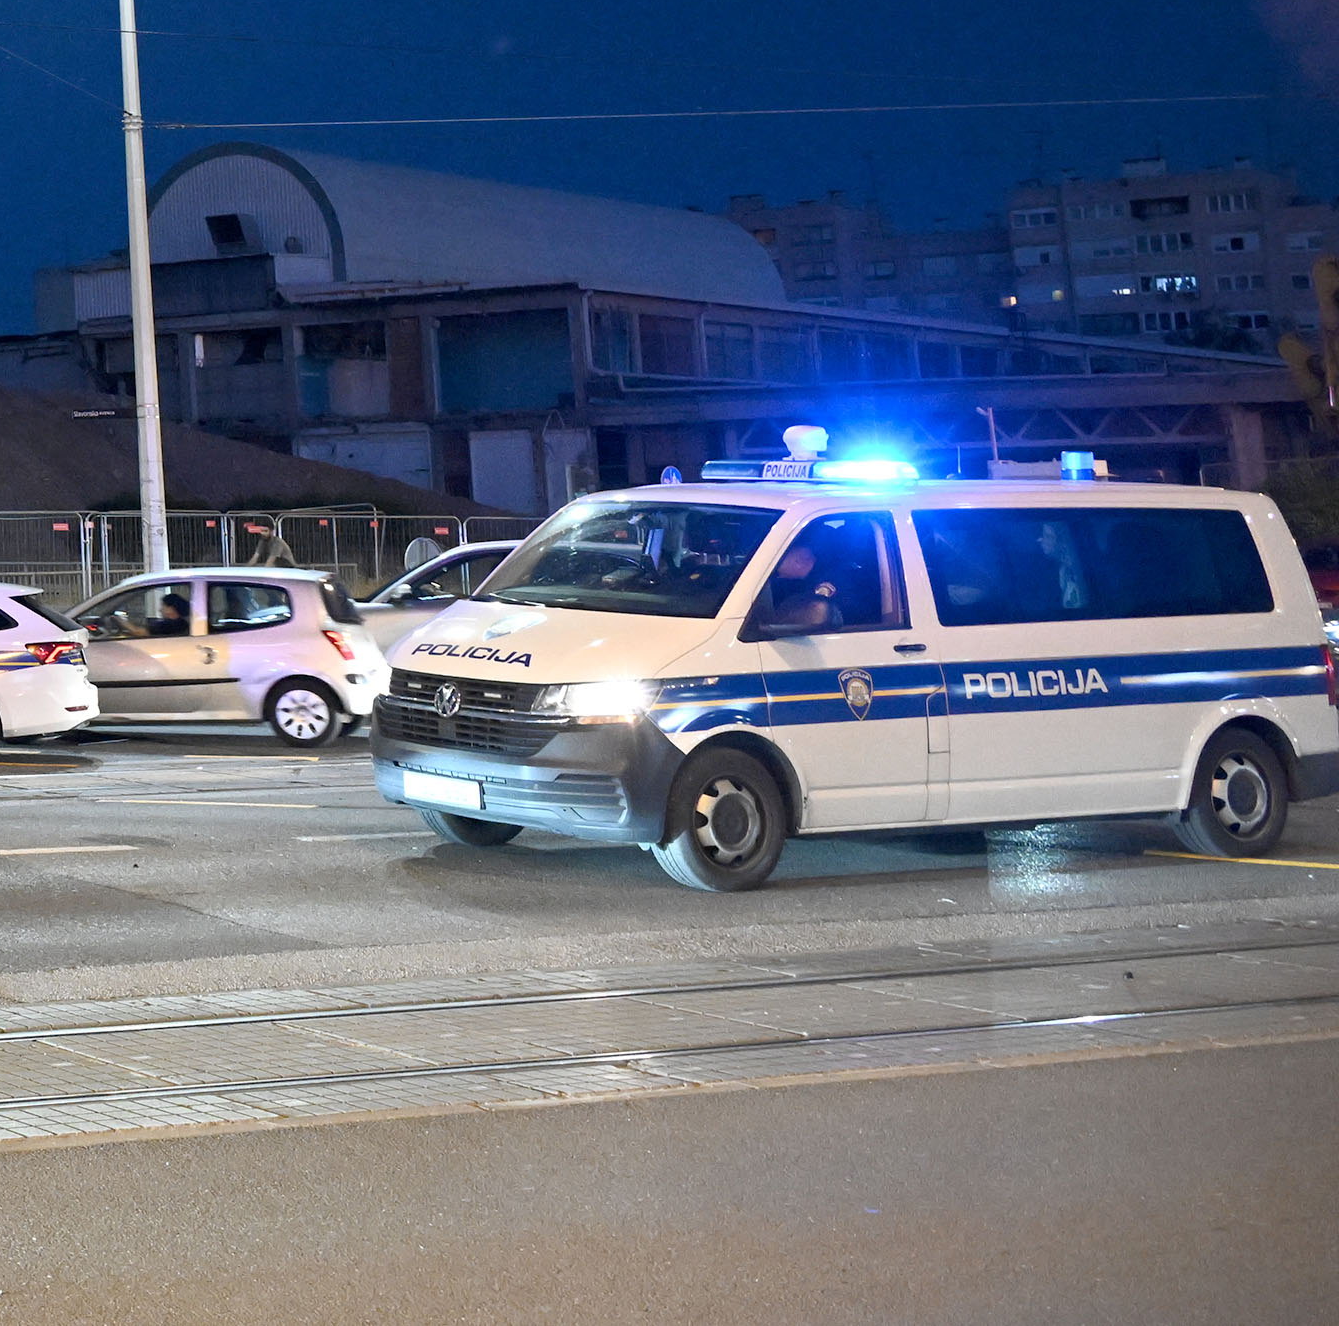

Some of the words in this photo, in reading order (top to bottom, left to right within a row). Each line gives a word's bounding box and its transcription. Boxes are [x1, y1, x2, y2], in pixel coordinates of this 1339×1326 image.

[765, 464, 808, 478] POLICIJA
[411, 643, 532, 667] POLICIJA
[963, 668, 1109, 699] POLICIJA
